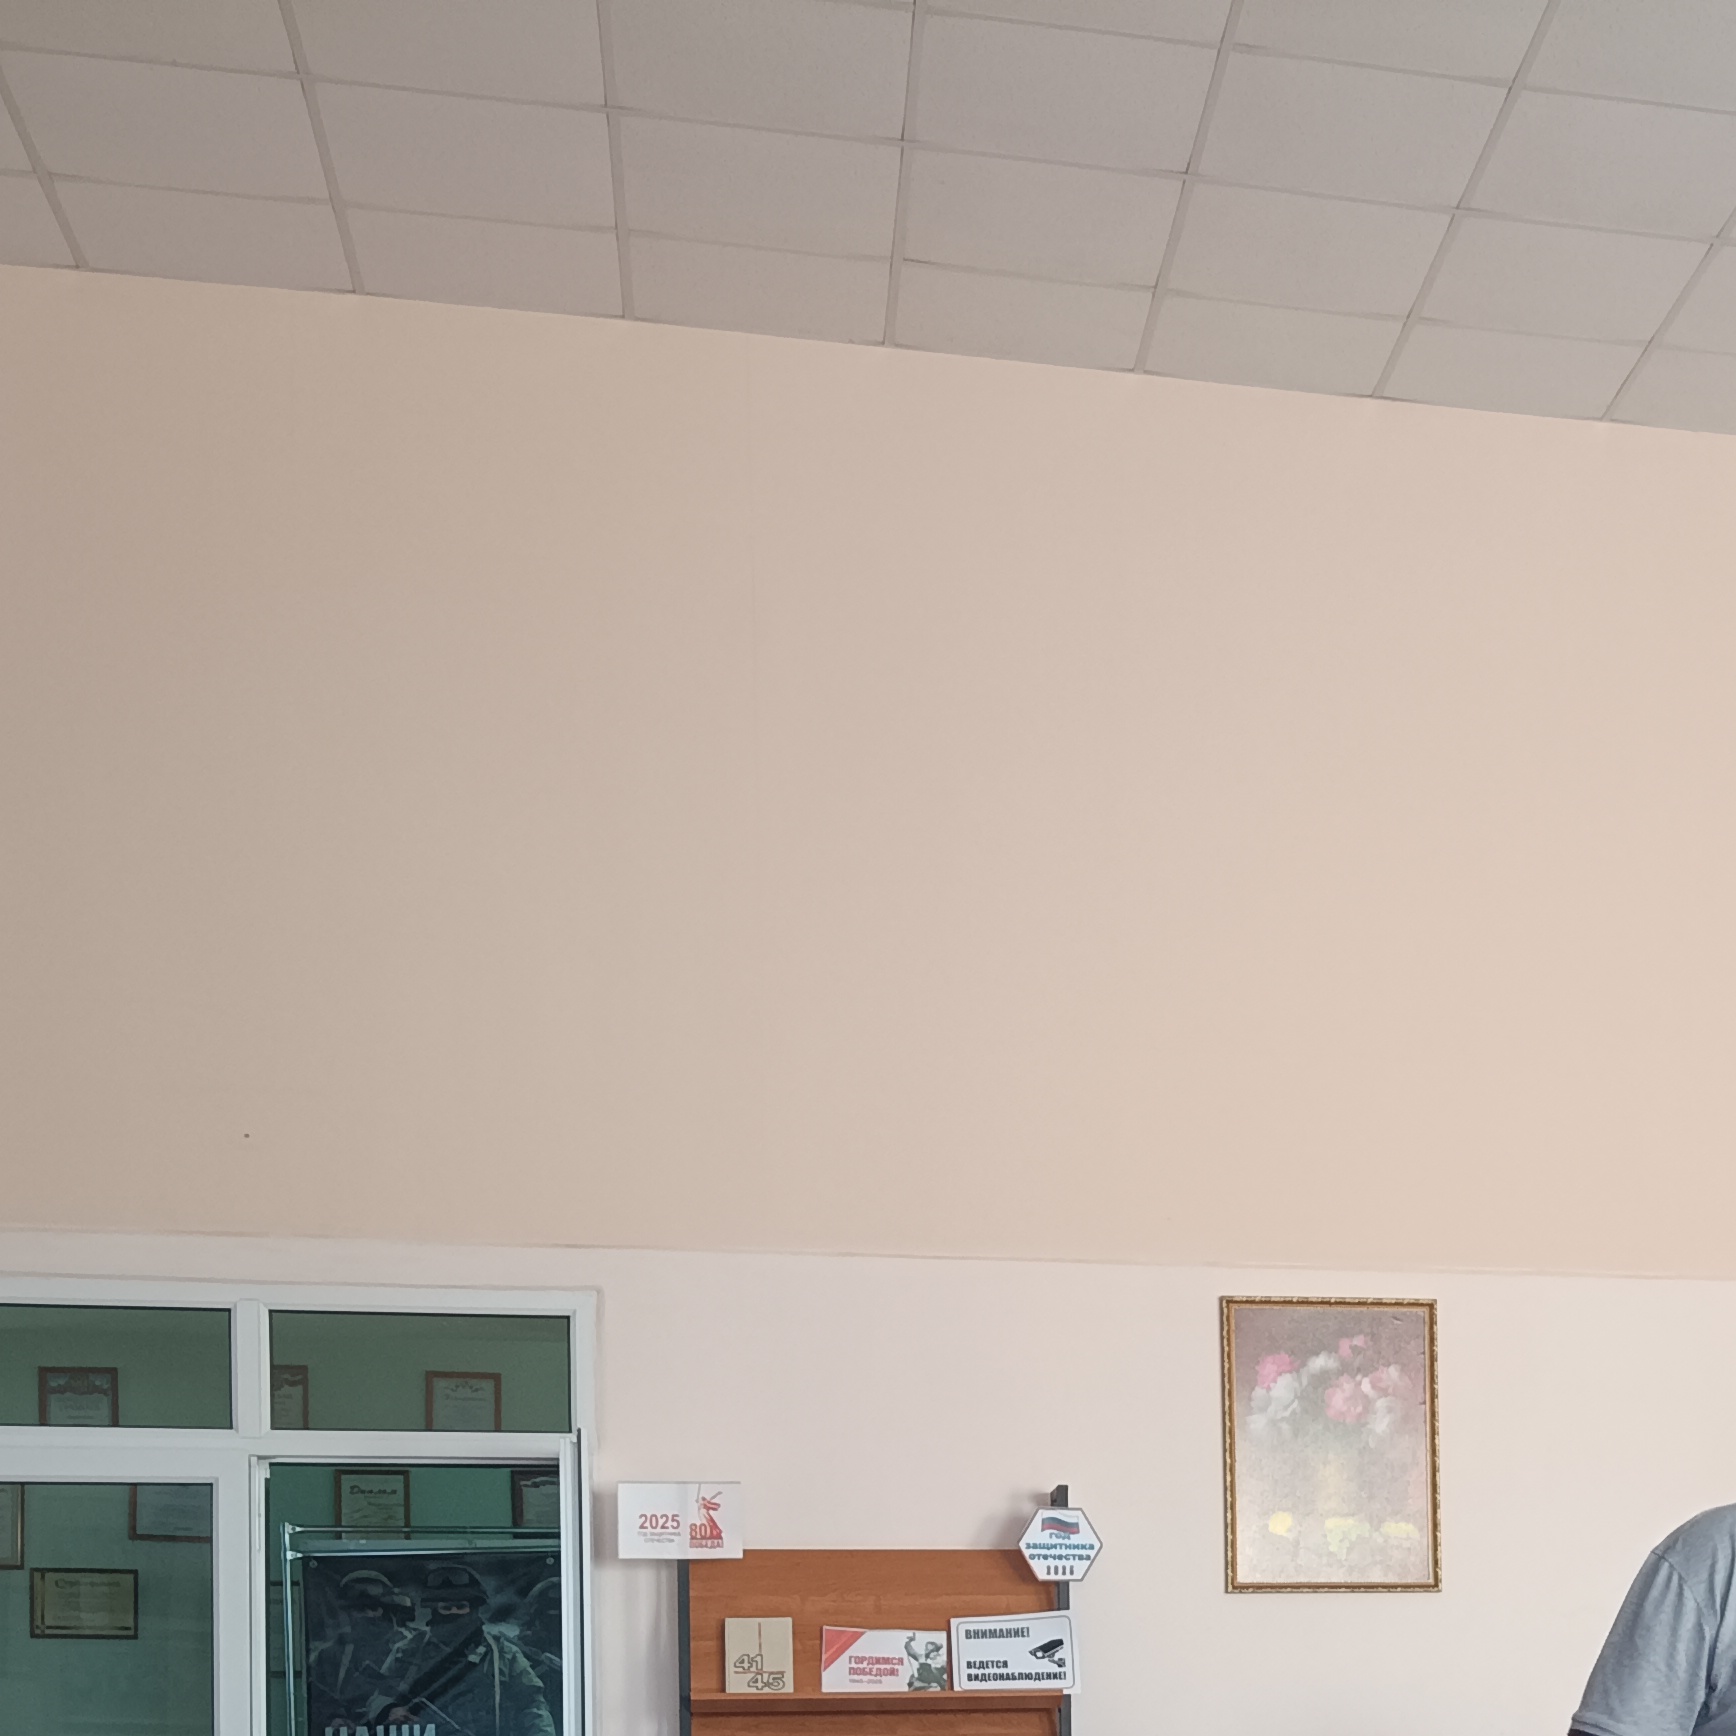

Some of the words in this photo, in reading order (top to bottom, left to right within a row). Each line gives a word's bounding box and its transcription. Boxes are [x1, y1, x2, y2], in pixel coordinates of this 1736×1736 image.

[638, 1513, 681, 1530] 2025
[964, 1626, 1030, 1640] ВНИМАНИЕ!
[733, 1653, 764, 1671] 41
[848, 1655, 904, 1666] ГОРДИМСЯ
[966, 1659, 1009, 1670] ВЕДЕТСЯ
[848, 1666, 899, 1678] ПОБЕДОЙ!
[966, 1670, 1067, 1682] ВИДЕОНАБЛЮДЕНИЕ!
[747, 1671, 786, 1691] 45
